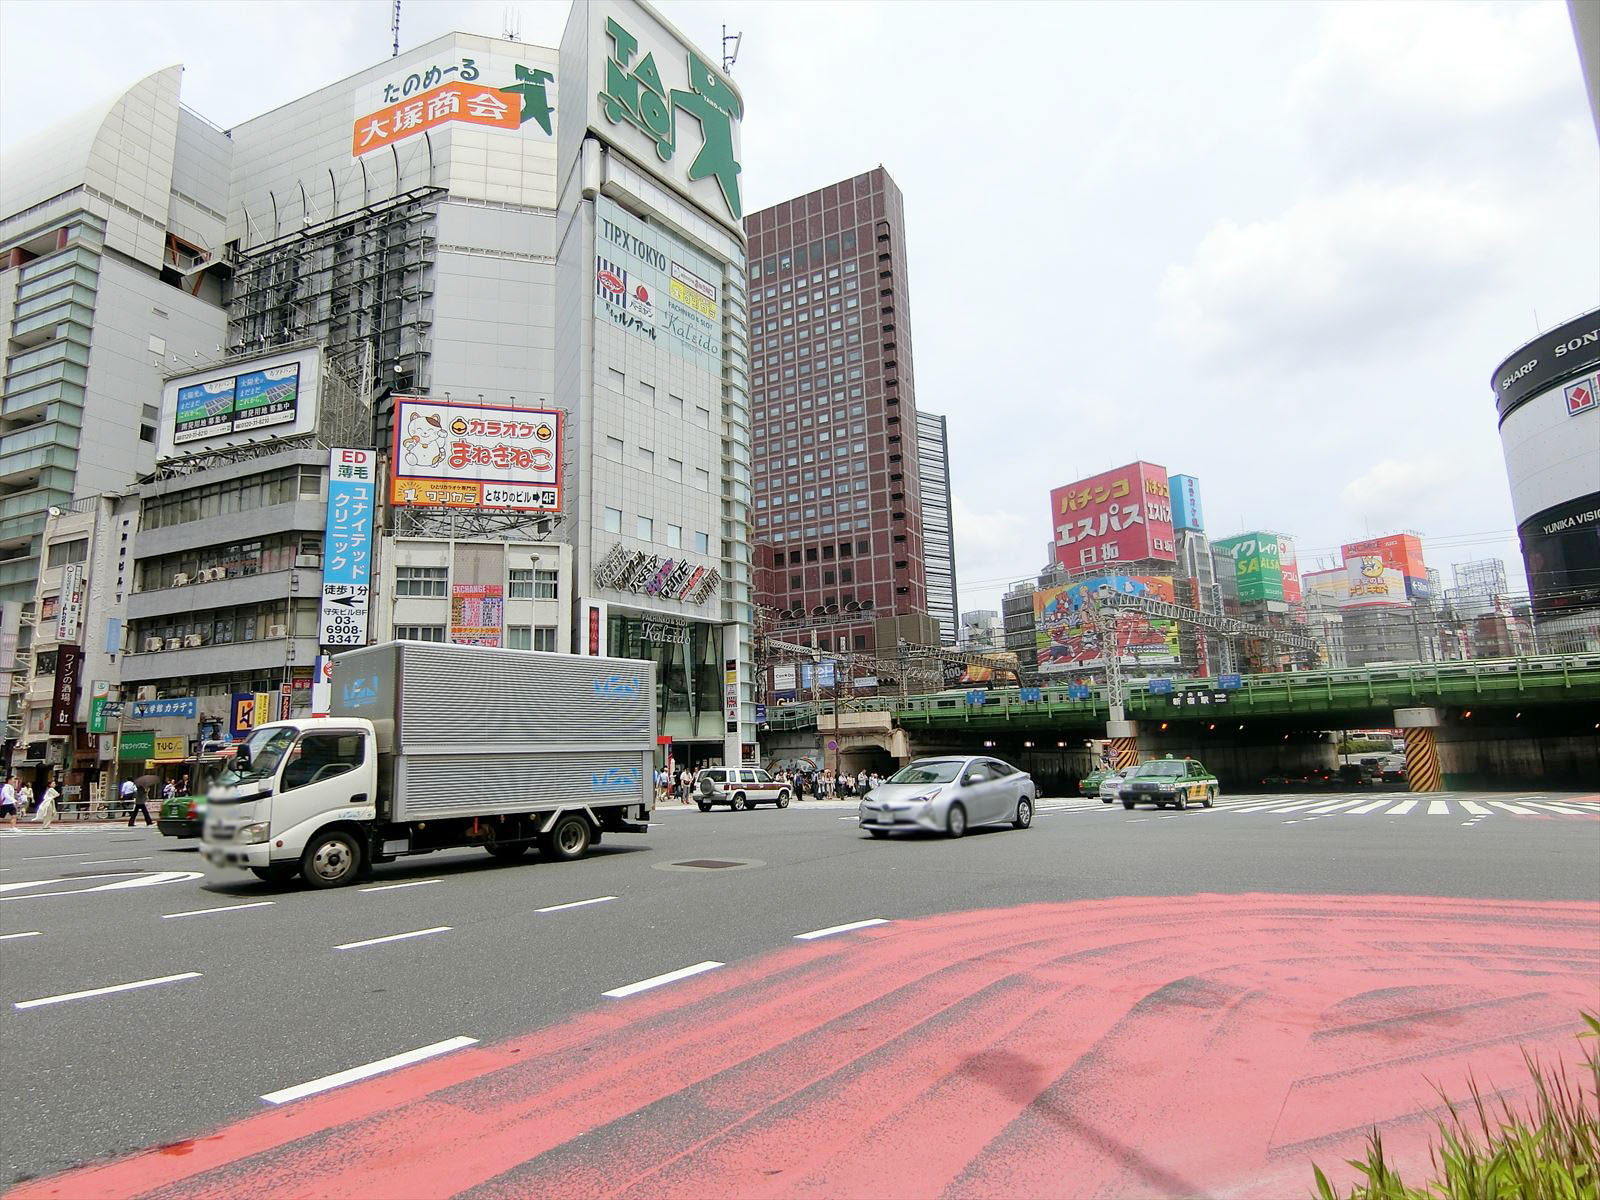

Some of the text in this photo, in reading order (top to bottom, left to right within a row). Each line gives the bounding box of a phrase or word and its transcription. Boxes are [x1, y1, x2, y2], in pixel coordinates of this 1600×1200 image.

[383, 59, 480, 103] たのめーる
[360, 91, 508, 147] 大塚商会
[632, 237, 666, 272] TOKYO
[662, 312, 718, 354] Kaleido
[1555, 329, 1600, 357] SON
[1502, 359, 1538, 390] SHARP
[470, 419, 535, 438] カラオケ
[342, 450, 367, 464] ED
[449, 439, 553, 472] まねきねこ
[338, 465, 368, 479] 薄毛
[425, 491, 477, 503] ワンカラ
[485, 490, 556, 504] となりのビル 4F
[1061, 478, 1130, 514] パチンコ
[1147, 501, 1173, 523] エスパス
[331, 493, 350, 570] クリニック
[350, 487, 369, 580] ユナイテッド
[1056, 503, 1144, 547] エスパス
[1543, 517, 1576, 535] YUNIKA
[1080, 541, 1119, 566] 日拓
[324, 585, 368, 596] 徒歩1分
[326, 625, 362, 635] 6908-
[335, 616, 355, 625] 03-
[327, 634, 360, 644] 8347
[640, 622, 690, 644] Kaleido
[164, 702, 187, 713] カラテ
